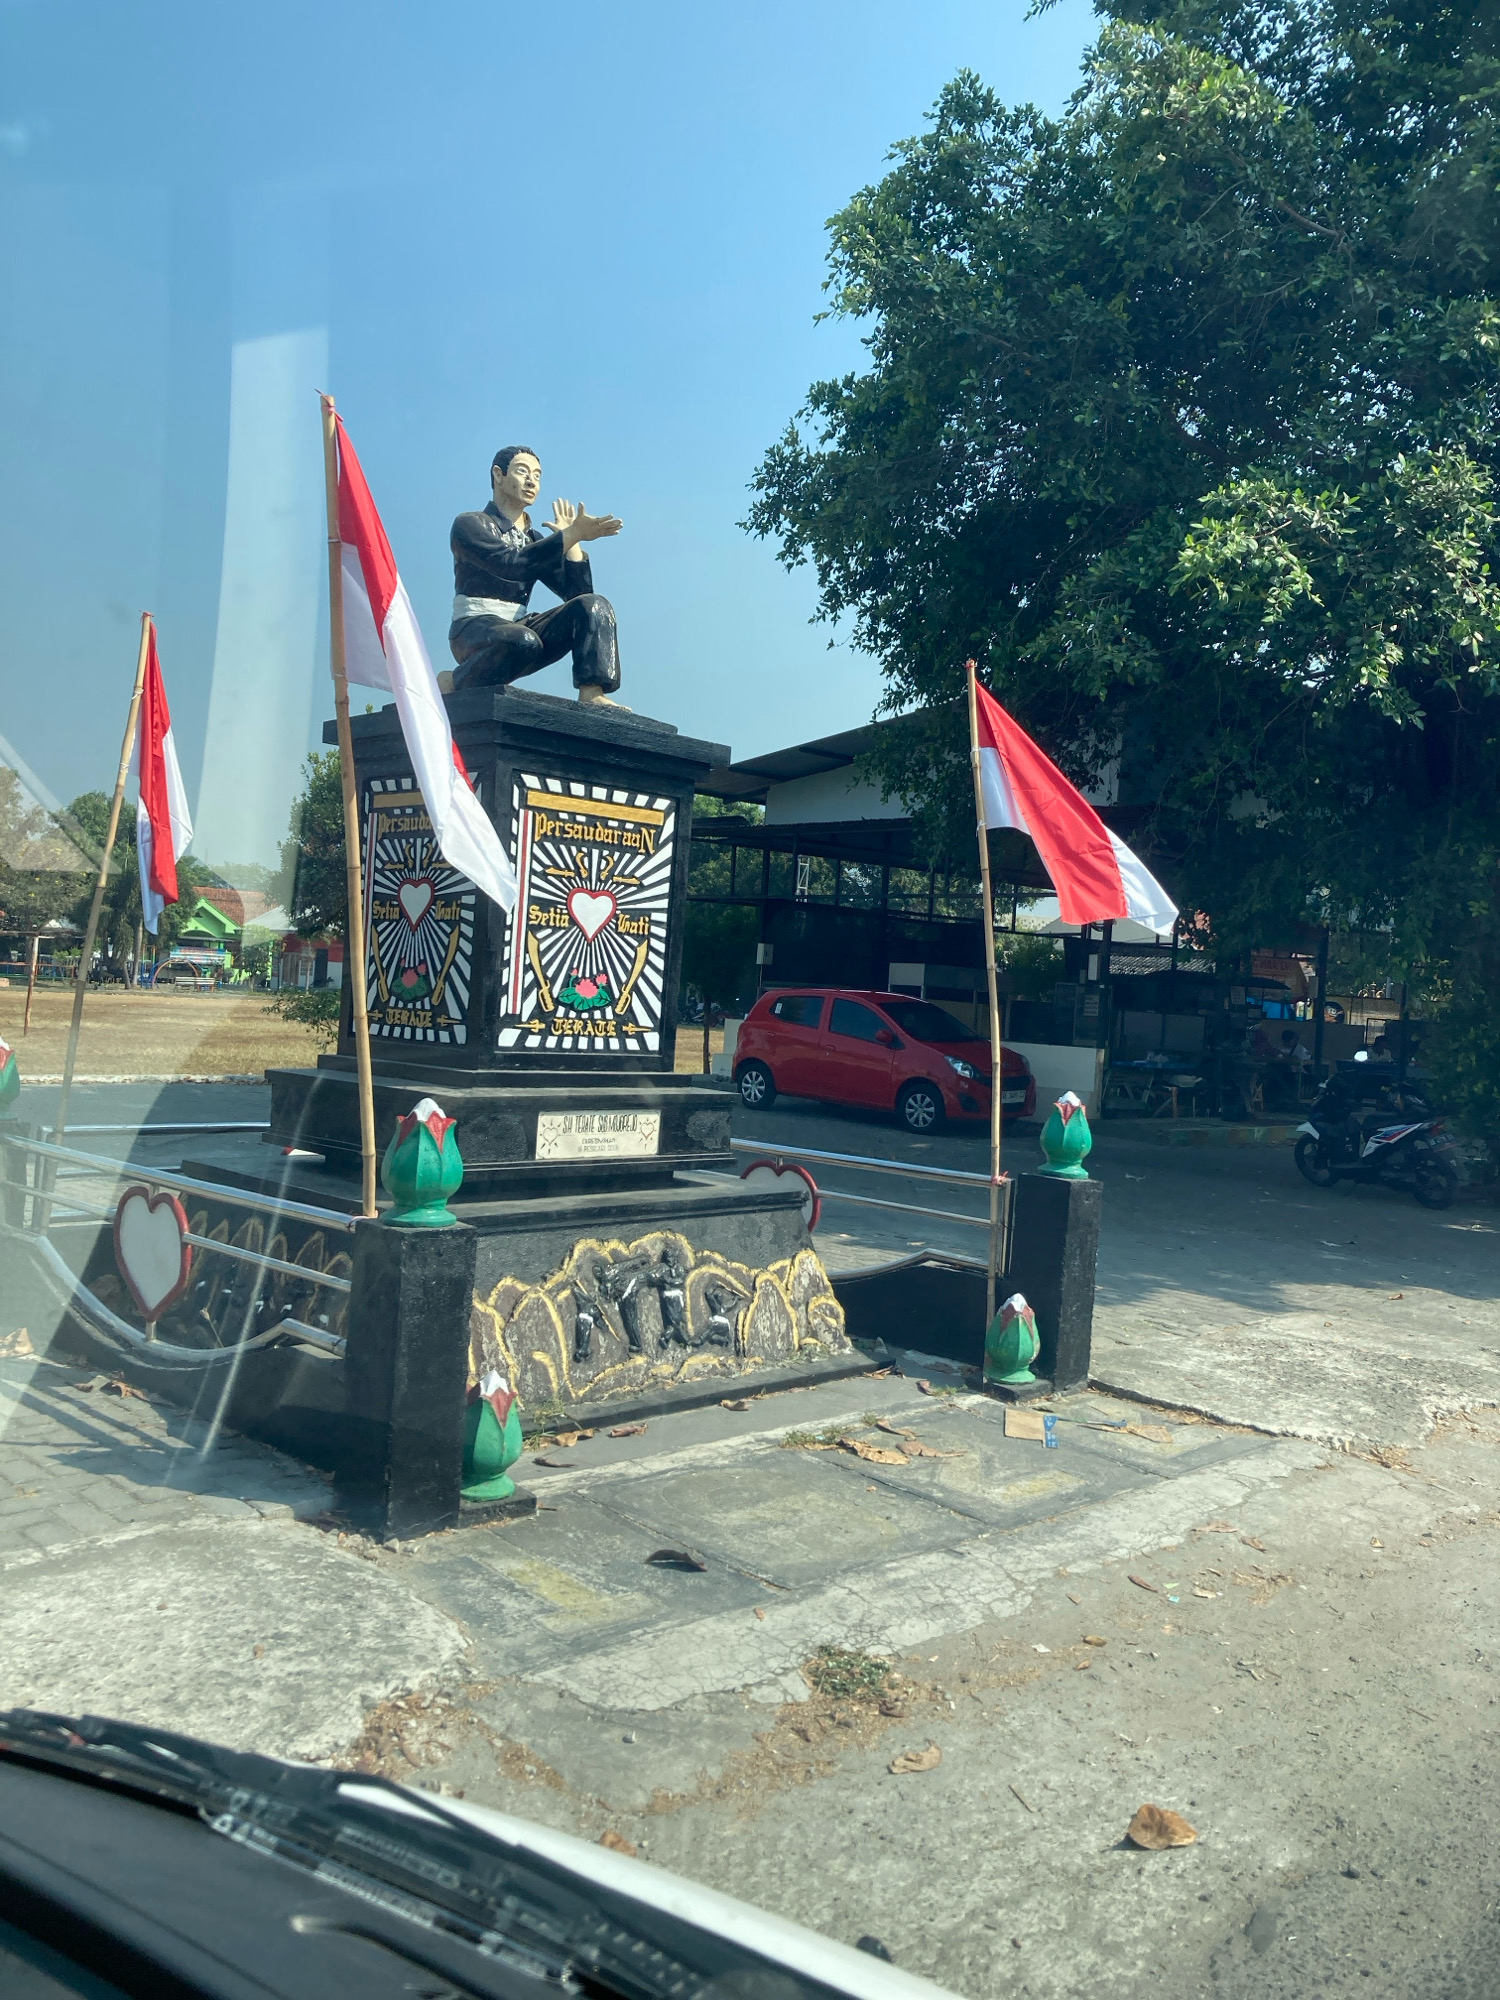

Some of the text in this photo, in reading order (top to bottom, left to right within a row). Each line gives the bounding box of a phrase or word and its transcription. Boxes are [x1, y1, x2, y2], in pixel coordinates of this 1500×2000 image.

[528, 904, 570, 928] Setia
[551, 1017, 617, 1037] TERATE
[575, 1114, 596, 1133] TERATE
